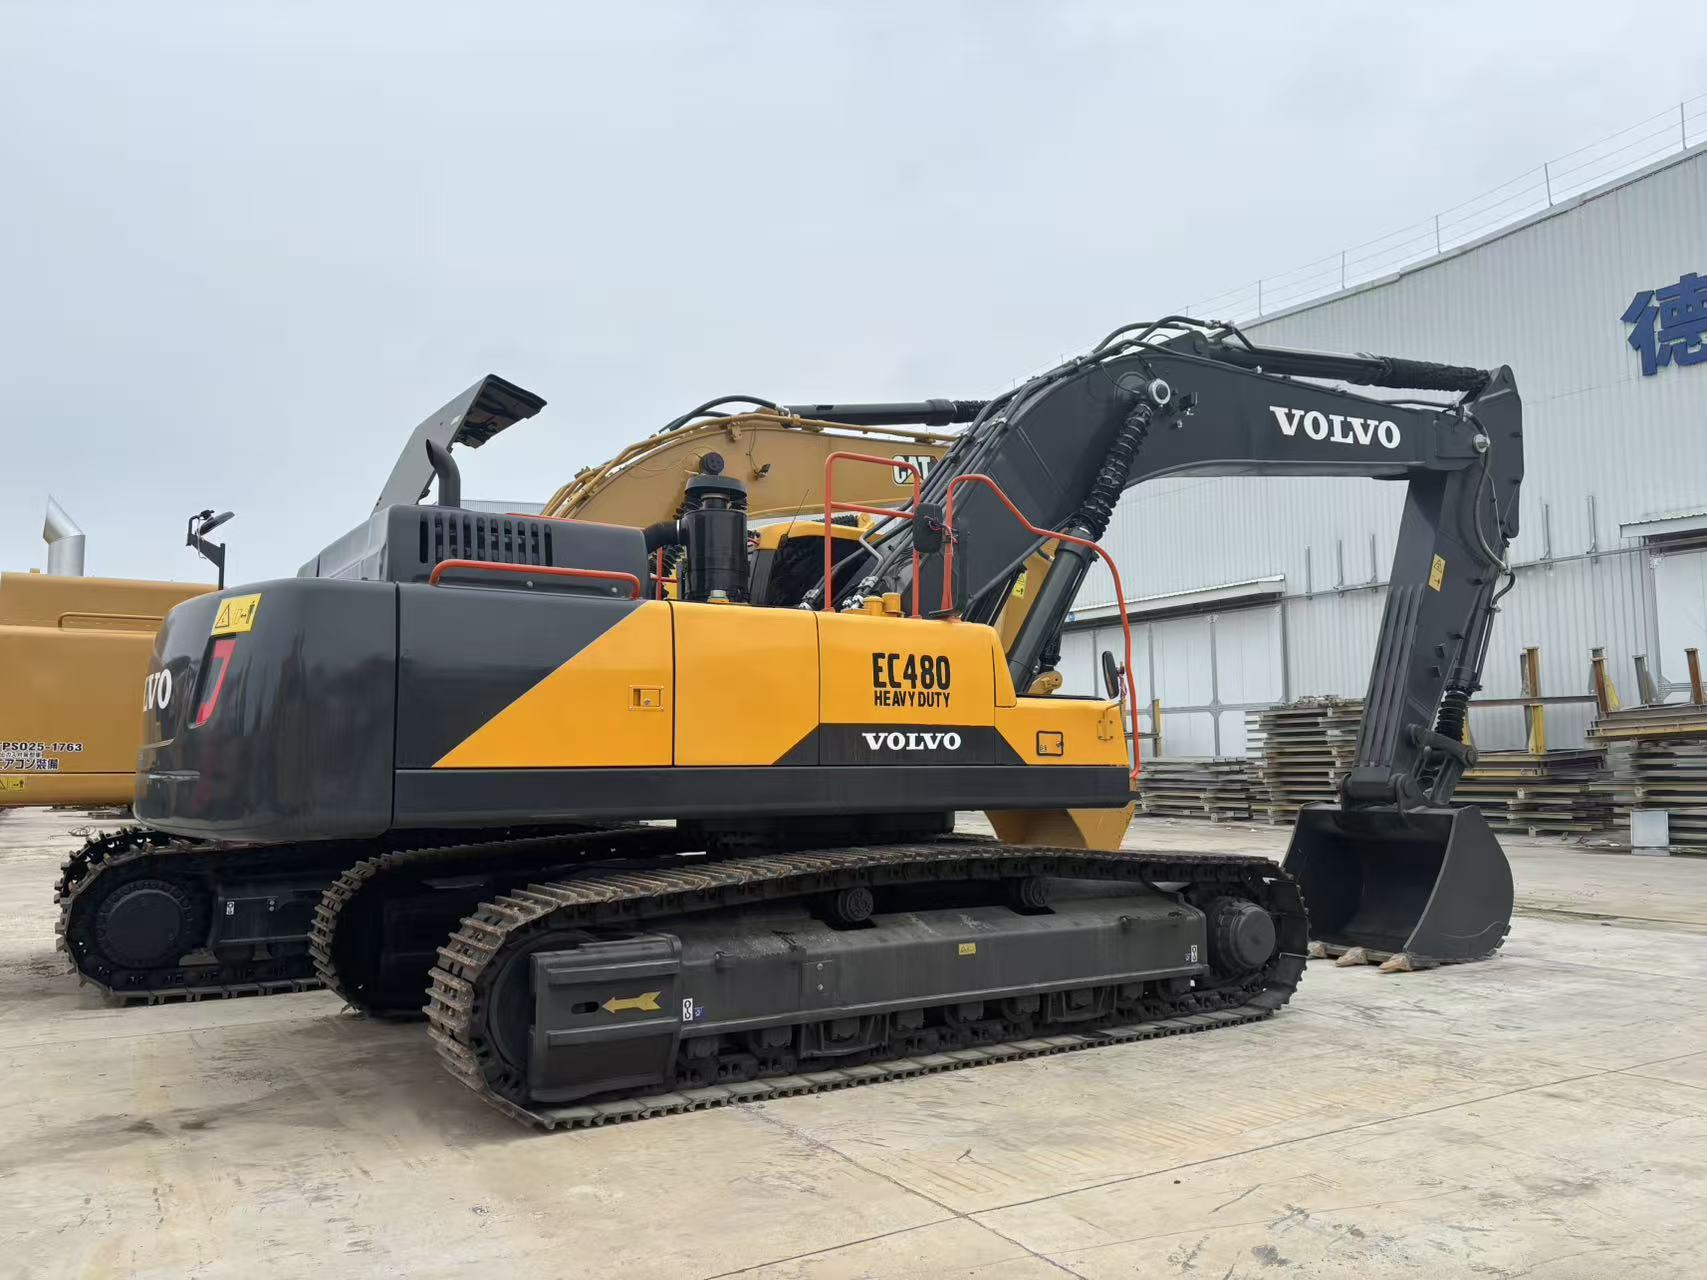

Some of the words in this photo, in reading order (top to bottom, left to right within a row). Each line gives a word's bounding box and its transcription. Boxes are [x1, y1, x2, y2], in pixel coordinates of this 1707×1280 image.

[1269, 405, 1401, 449] VOLVO
[893, 455, 931, 484] CAT
[872, 652, 951, 690] EC480
[874, 690, 915, 707] HEAVY
[918, 692, 950, 708] DUTY
[0, 742, 82, 752] PS025-1763
[861, 732, 961, 750] VOLVO
